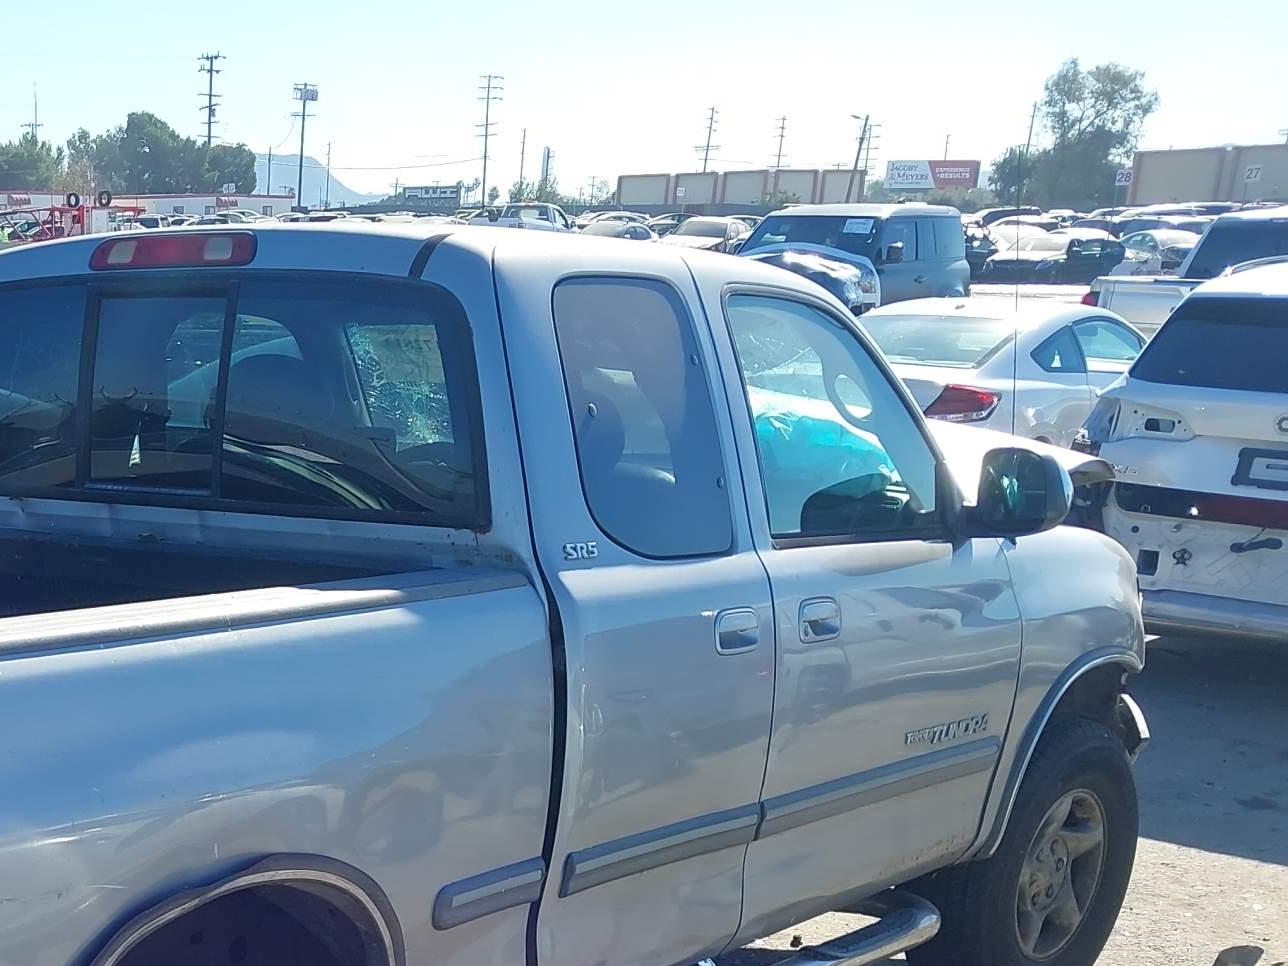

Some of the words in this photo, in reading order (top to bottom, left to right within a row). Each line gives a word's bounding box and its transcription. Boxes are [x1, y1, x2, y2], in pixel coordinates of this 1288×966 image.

[890, 162, 919, 171] JACOBY
[888, 173, 896, 181] &
[898, 172, 929, 180] MEYERS
[1116, 172, 1132, 183] 28
[1245, 167, 1261, 180] 27
[563, 541, 599, 560] SR5
[931, 713, 988, 744] TUNDRA
